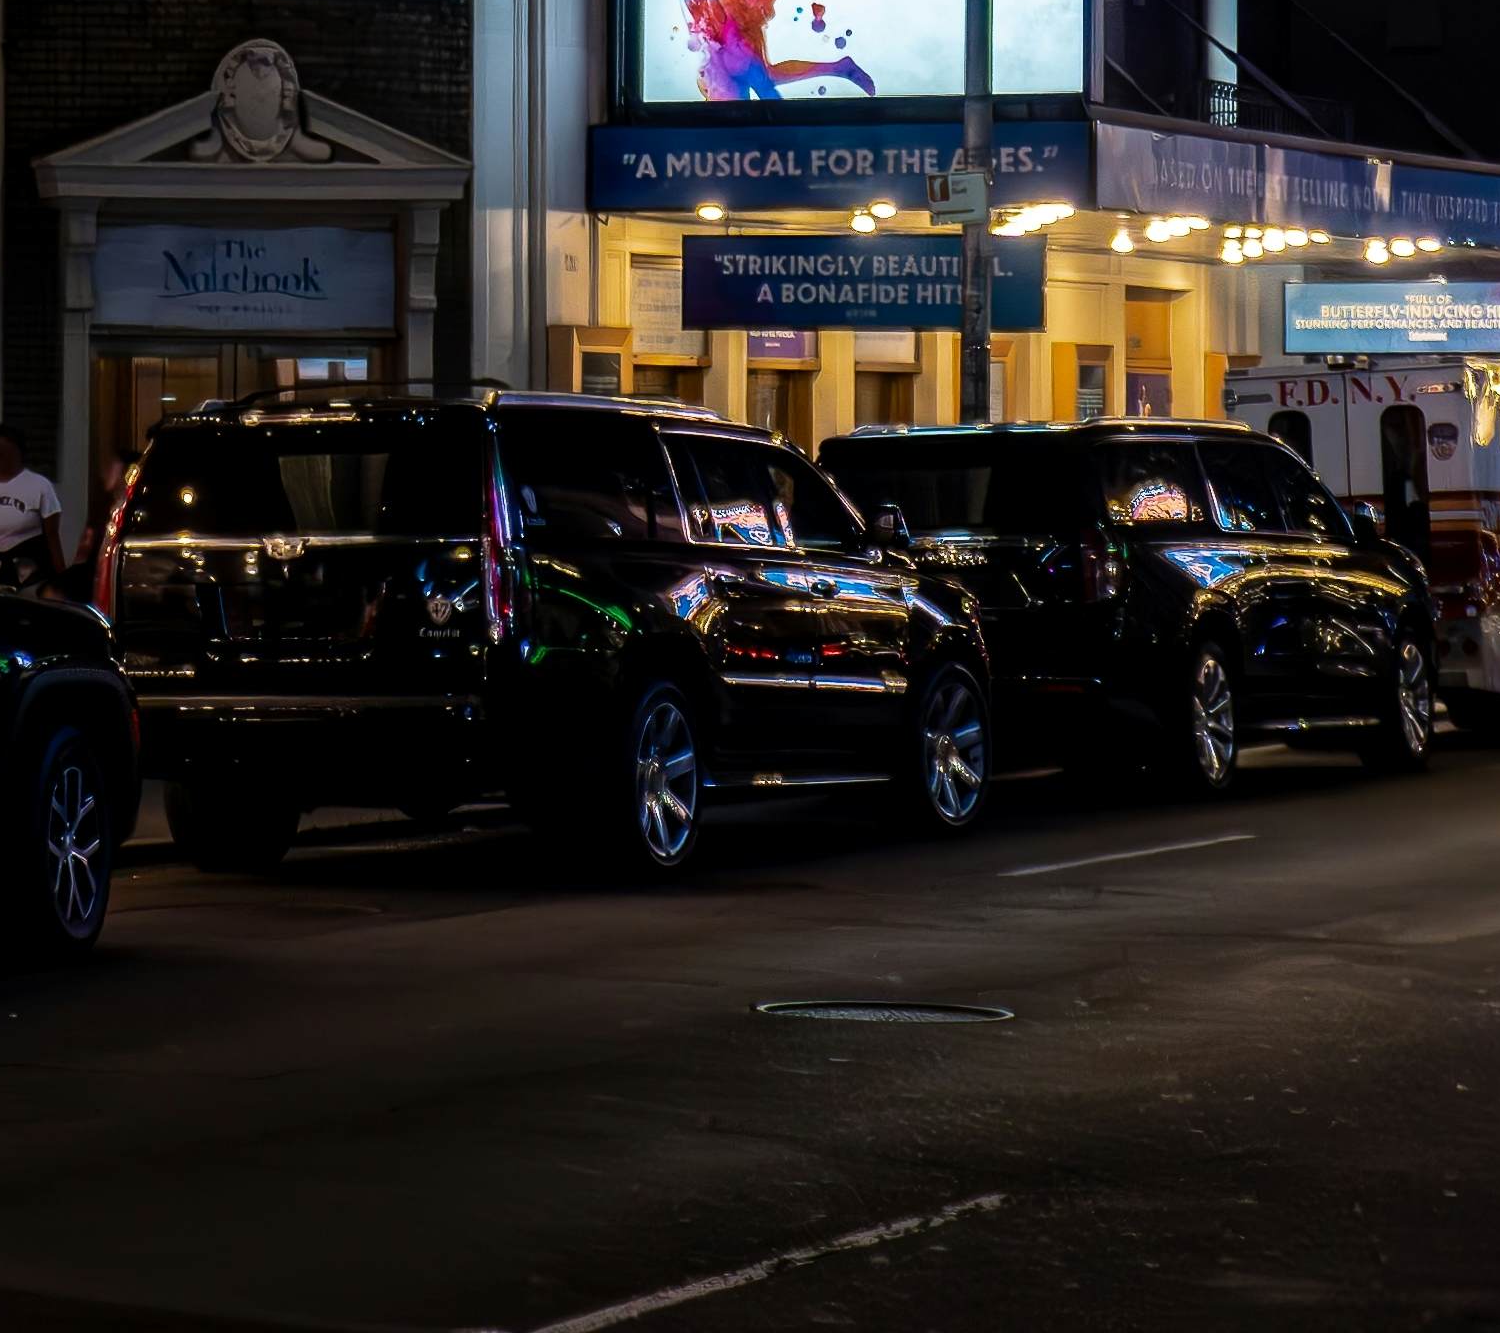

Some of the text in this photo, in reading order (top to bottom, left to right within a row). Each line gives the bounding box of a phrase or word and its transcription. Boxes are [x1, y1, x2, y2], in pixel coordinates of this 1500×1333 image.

[665, 150, 801, 179] MUSICAL
[810, 149, 875, 178] FOR
[883, 147, 940, 175] THE
[222, 239, 267, 259] The
[714, 253, 1014, 278] "STRIKINGLY BEAUTIL.
[756, 282, 774, 304] A
[781, 282, 909, 305] BONAFIDE
[1320, 304, 1484, 319] BUTTERFLY-INDUCING
